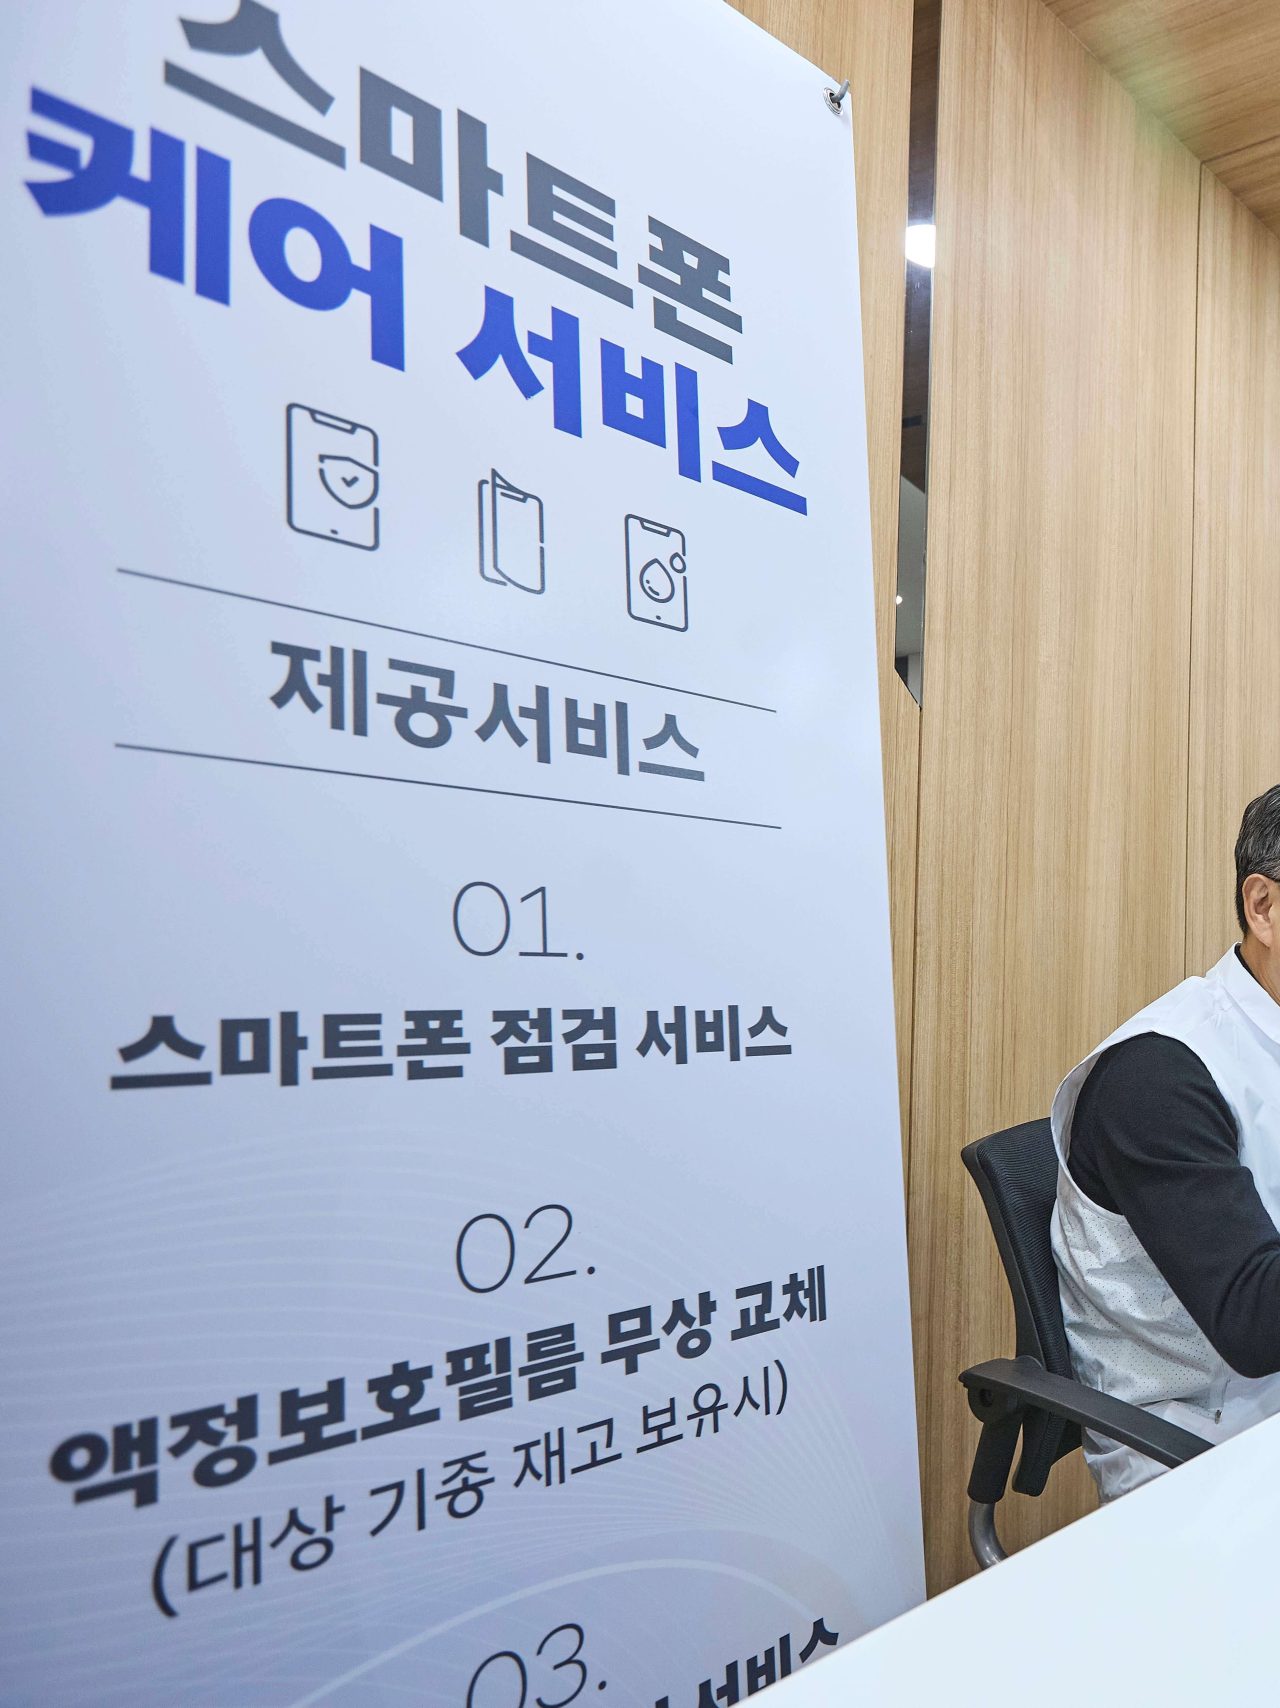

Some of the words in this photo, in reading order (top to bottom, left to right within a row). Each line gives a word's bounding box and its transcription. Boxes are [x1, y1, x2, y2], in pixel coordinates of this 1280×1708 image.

[164, 0, 743, 364] 스마트폰
[23, 85, 406, 372] 케어
[455, 285, 808, 517] 서비스
[270, 640, 706, 782] 제공서비스
[452, 881, 585, 961] 01.
[110, 1008, 471, 1090] 스마트폰
[491, 1006, 619, 1075] 점검
[636, 1004, 794, 1066] 서비스
[455, 1203, 597, 1294] 02.
[49, 1323, 585, 1508] 액정보호필름
[601, 1291, 719, 1375] 무상
[729, 1265, 827, 1343] 교체
[152, 1495, 346, 1618] (대상
[369, 1451, 497, 1536] 기종
[513, 1420, 623, 1490] 재고
[636, 1359, 789, 1453] 보유시)
[467, 1623, 608, 1708] 03.
